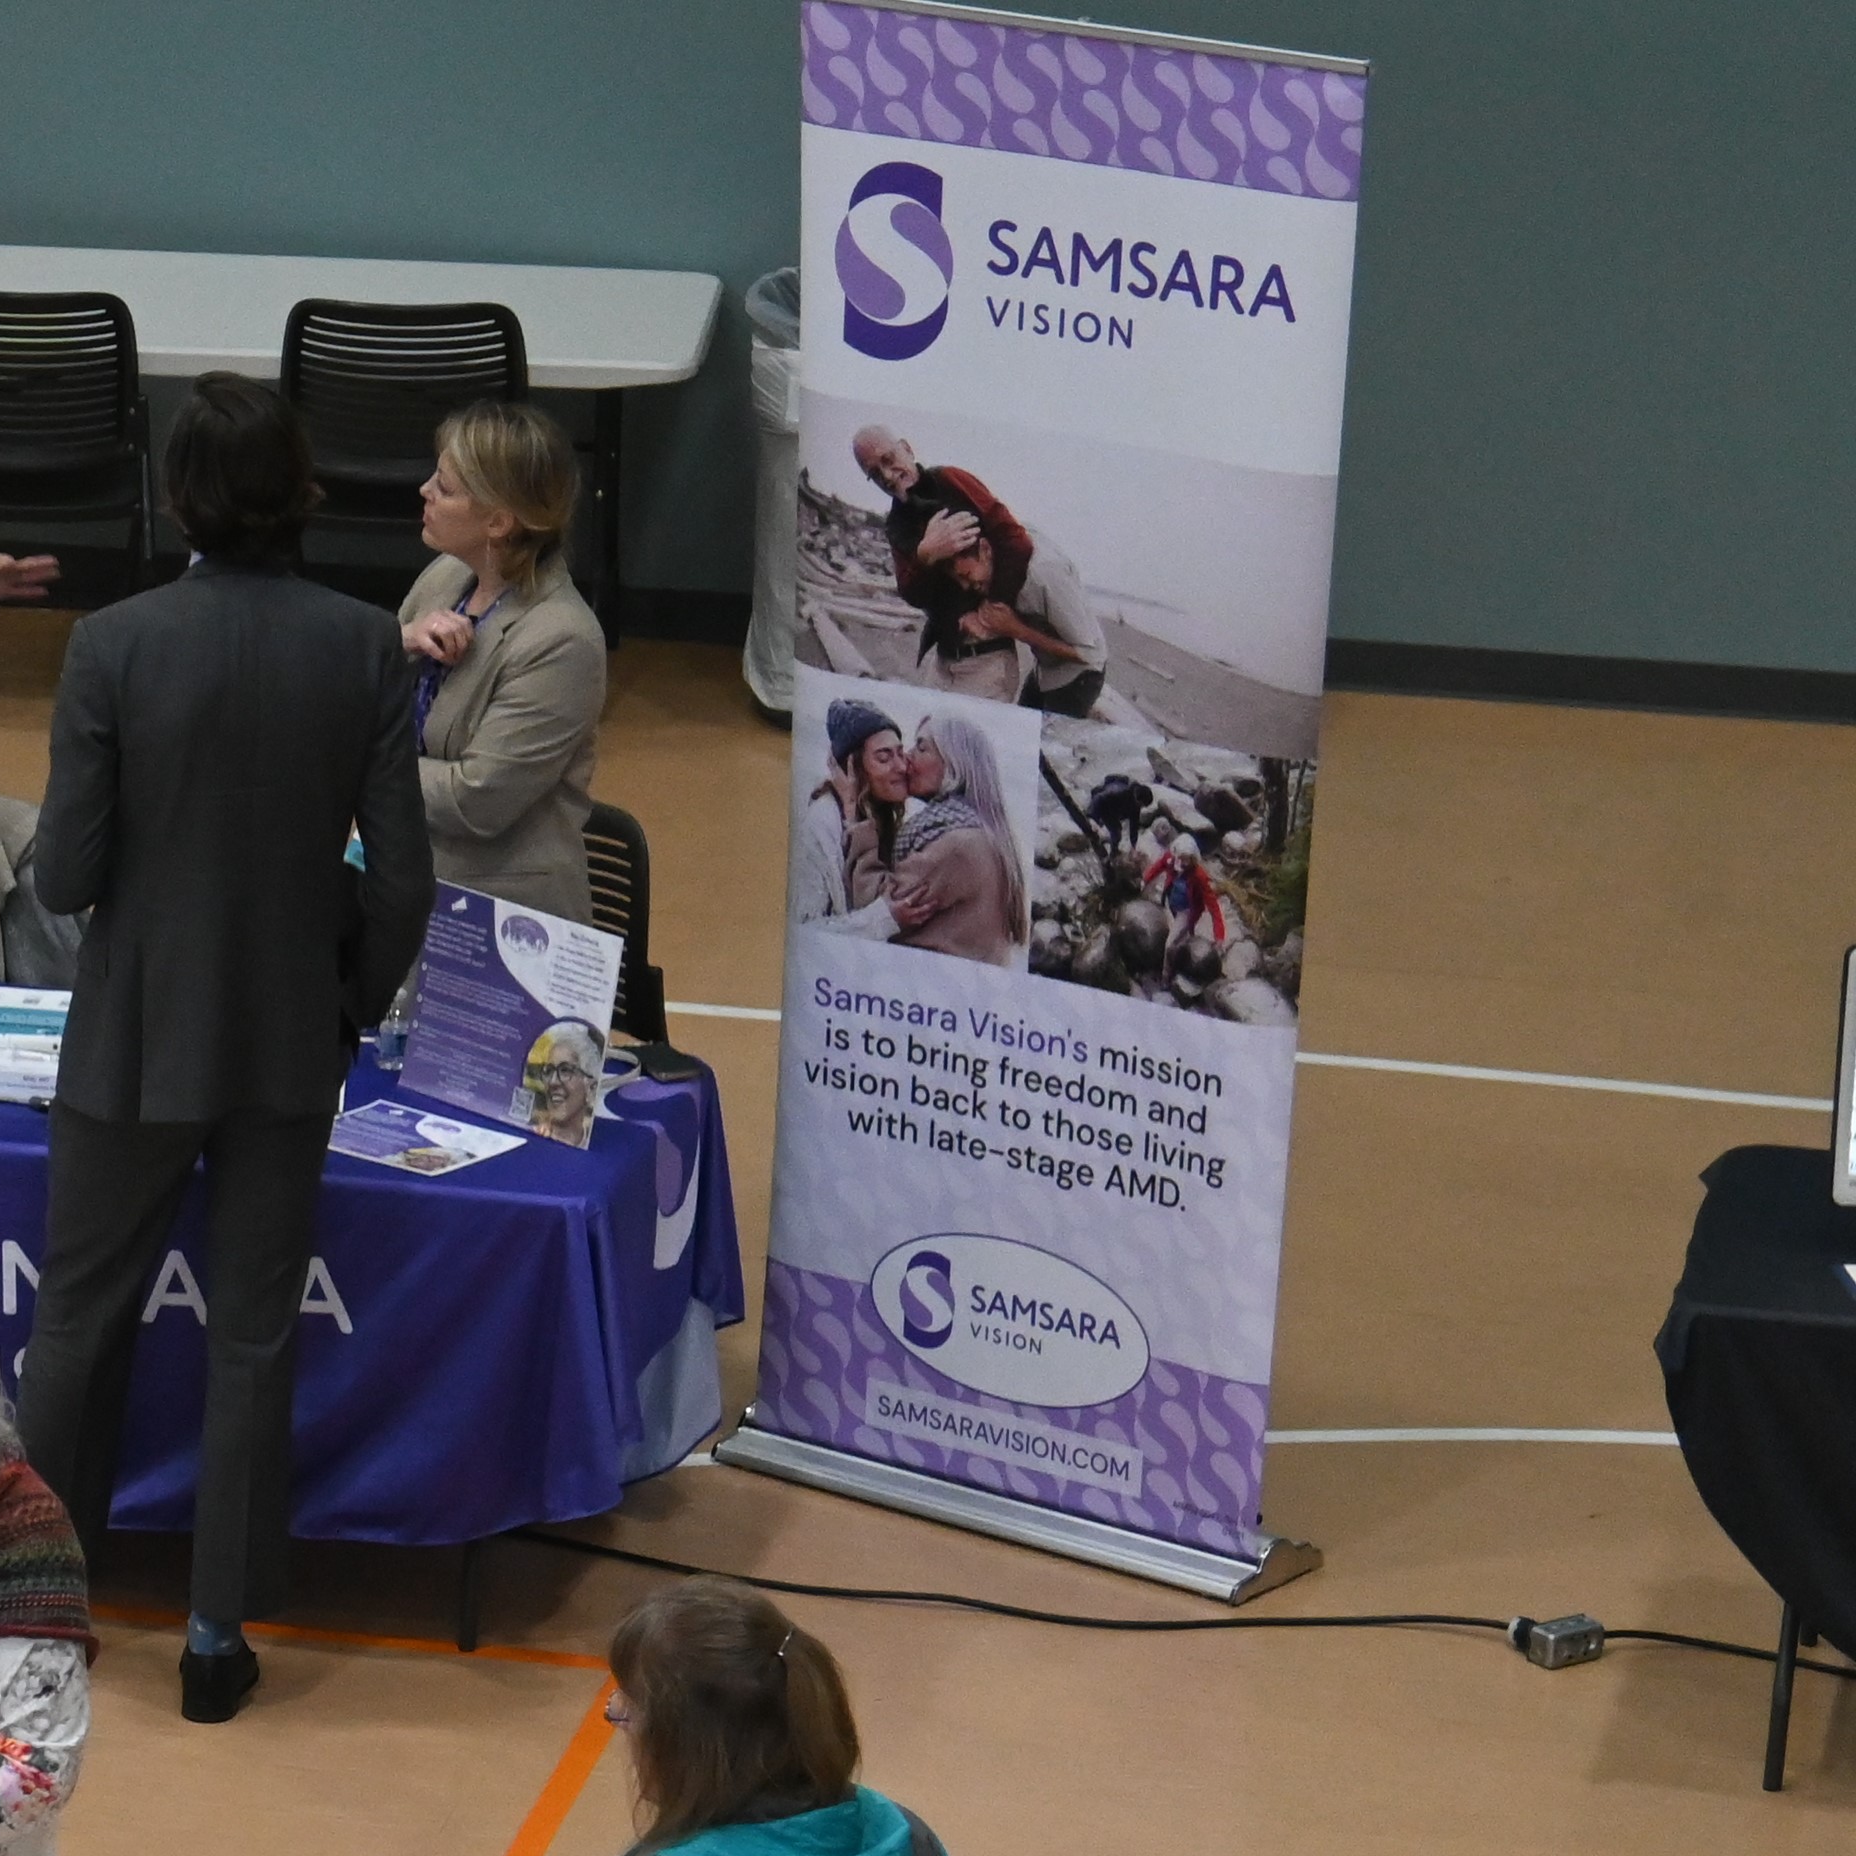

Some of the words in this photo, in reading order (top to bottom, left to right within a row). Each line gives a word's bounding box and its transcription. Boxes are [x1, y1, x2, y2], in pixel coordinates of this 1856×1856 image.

[986, 295, 1134, 349] VISION
[987, 219, 1296, 324] SAMSARA
[814, 977, 958, 1034] Samsara
[968, 1007, 1088, 1064] Vision's
[1099, 1042, 1223, 1097] mission
[825, 1018, 850, 1051] is
[861, 1029, 896, 1059] to
[907, 1034, 990, 1088] bring
[998, 1056, 1138, 1116] freedom
[1148, 1096, 1207, 1136] and
[804, 1058, 899, 1102] vision
[910, 1073, 987, 1121] back
[999, 1102, 1032, 1132] to
[1042, 1108, 1133, 1156] those
[1144, 1136, 1226, 1189] living
[847, 1109, 918, 1145] with
[928, 1123, 1095, 1189] late-stage
[1104, 1166, 1187, 1211] AMD.
[969, 1323, 1043, 1355] VISION
[970, 1285, 1121, 1349] SAMSARA
[877, 1395, 1131, 1481] SAMSARAVISION.COM
